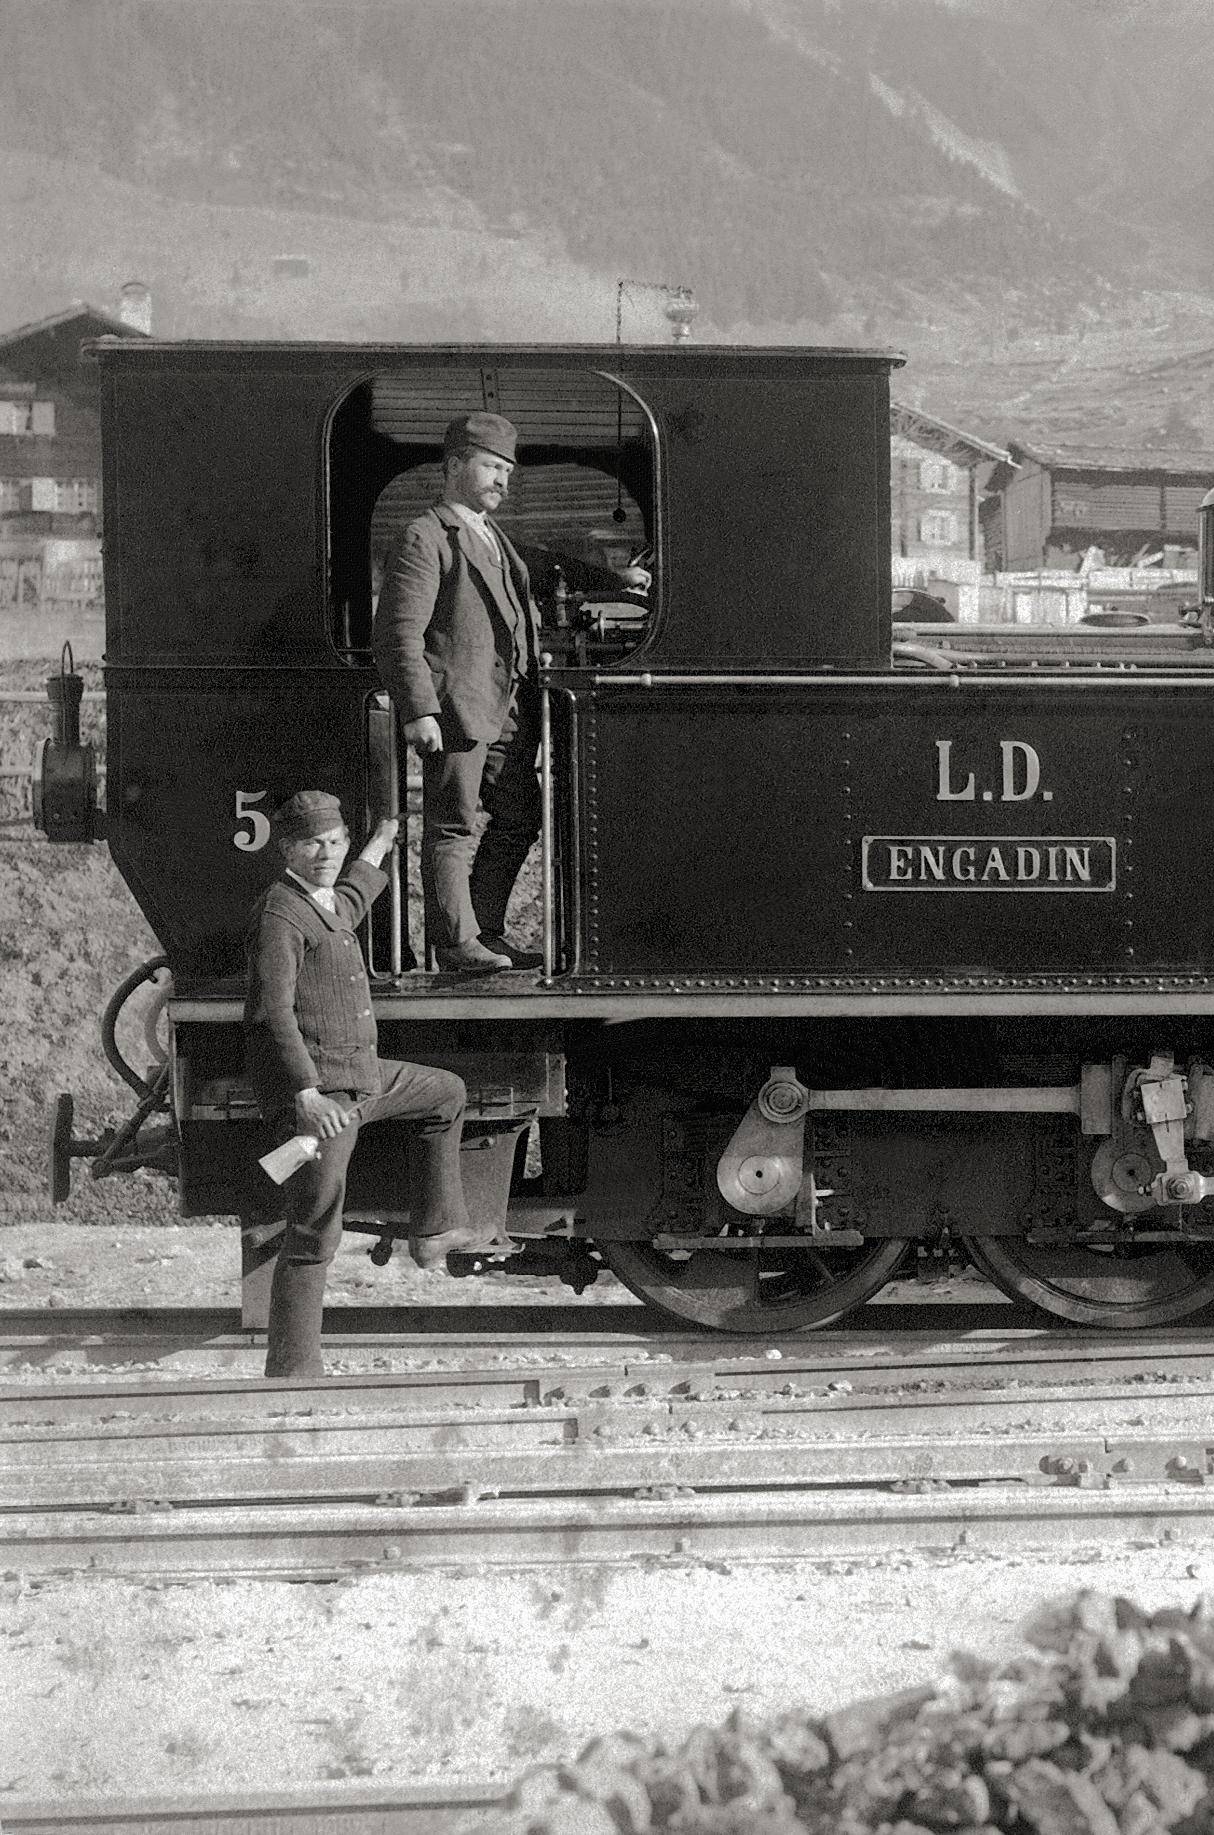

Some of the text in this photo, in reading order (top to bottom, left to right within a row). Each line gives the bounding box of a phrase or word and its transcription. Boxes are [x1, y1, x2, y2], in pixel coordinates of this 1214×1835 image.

[935, 740, 1053, 801] L.D.
[233, 790, 271, 852] 5
[888, 846, 1091, 881] ENGADIN
